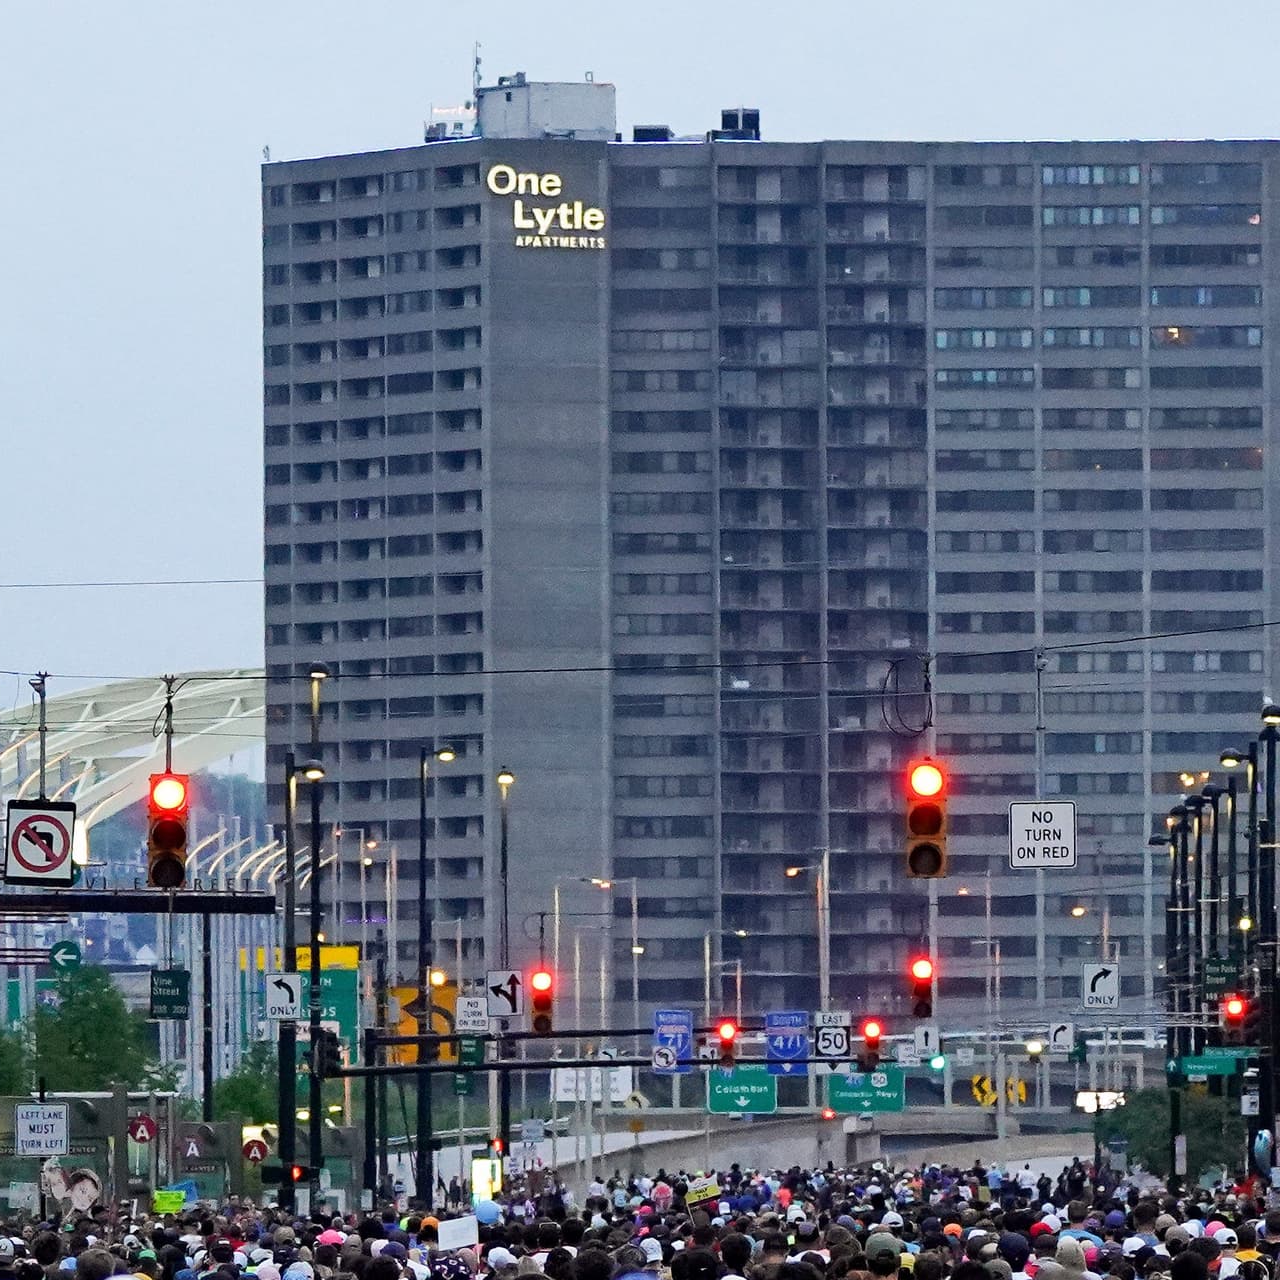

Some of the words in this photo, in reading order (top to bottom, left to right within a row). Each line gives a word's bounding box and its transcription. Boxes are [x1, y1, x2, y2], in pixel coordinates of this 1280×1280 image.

[487, 164, 562, 197] One
[513, 199, 605, 235] Lytle
[515, 235, 606, 249] APARTMENTS
[1032, 811, 1053, 823] NO
[1025, 829, 1062, 841] TURN
[1017, 847, 1036, 859] ON
[1042, 846, 1069, 858] RED
[86, 878, 144, 890] VIE
[153, 977, 172, 985] Vine
[153, 987, 179, 996] Street
[1088, 996, 1115, 1005] ONLY
[270, 1006, 297, 1016] ONLY
[464, 1010, 482, 1018] TURN
[822, 1015, 843, 1024] EAST
[663, 1033, 683, 1049] 71
[773, 1034, 801, 1049] 471
[821, 1032, 844, 1049] 50
[20, 1111, 40, 1120] LEFT
[42, 1111, 64, 1120] LANE
[29, 1123, 56, 1134] MUST
[135, 1124, 151, 1140] A
[20, 1139, 41, 1149] TURN
[45, 1139, 63, 1149] LEFT
[186, 1142, 200, 1158] A
[249, 1146, 262, 1160] A
